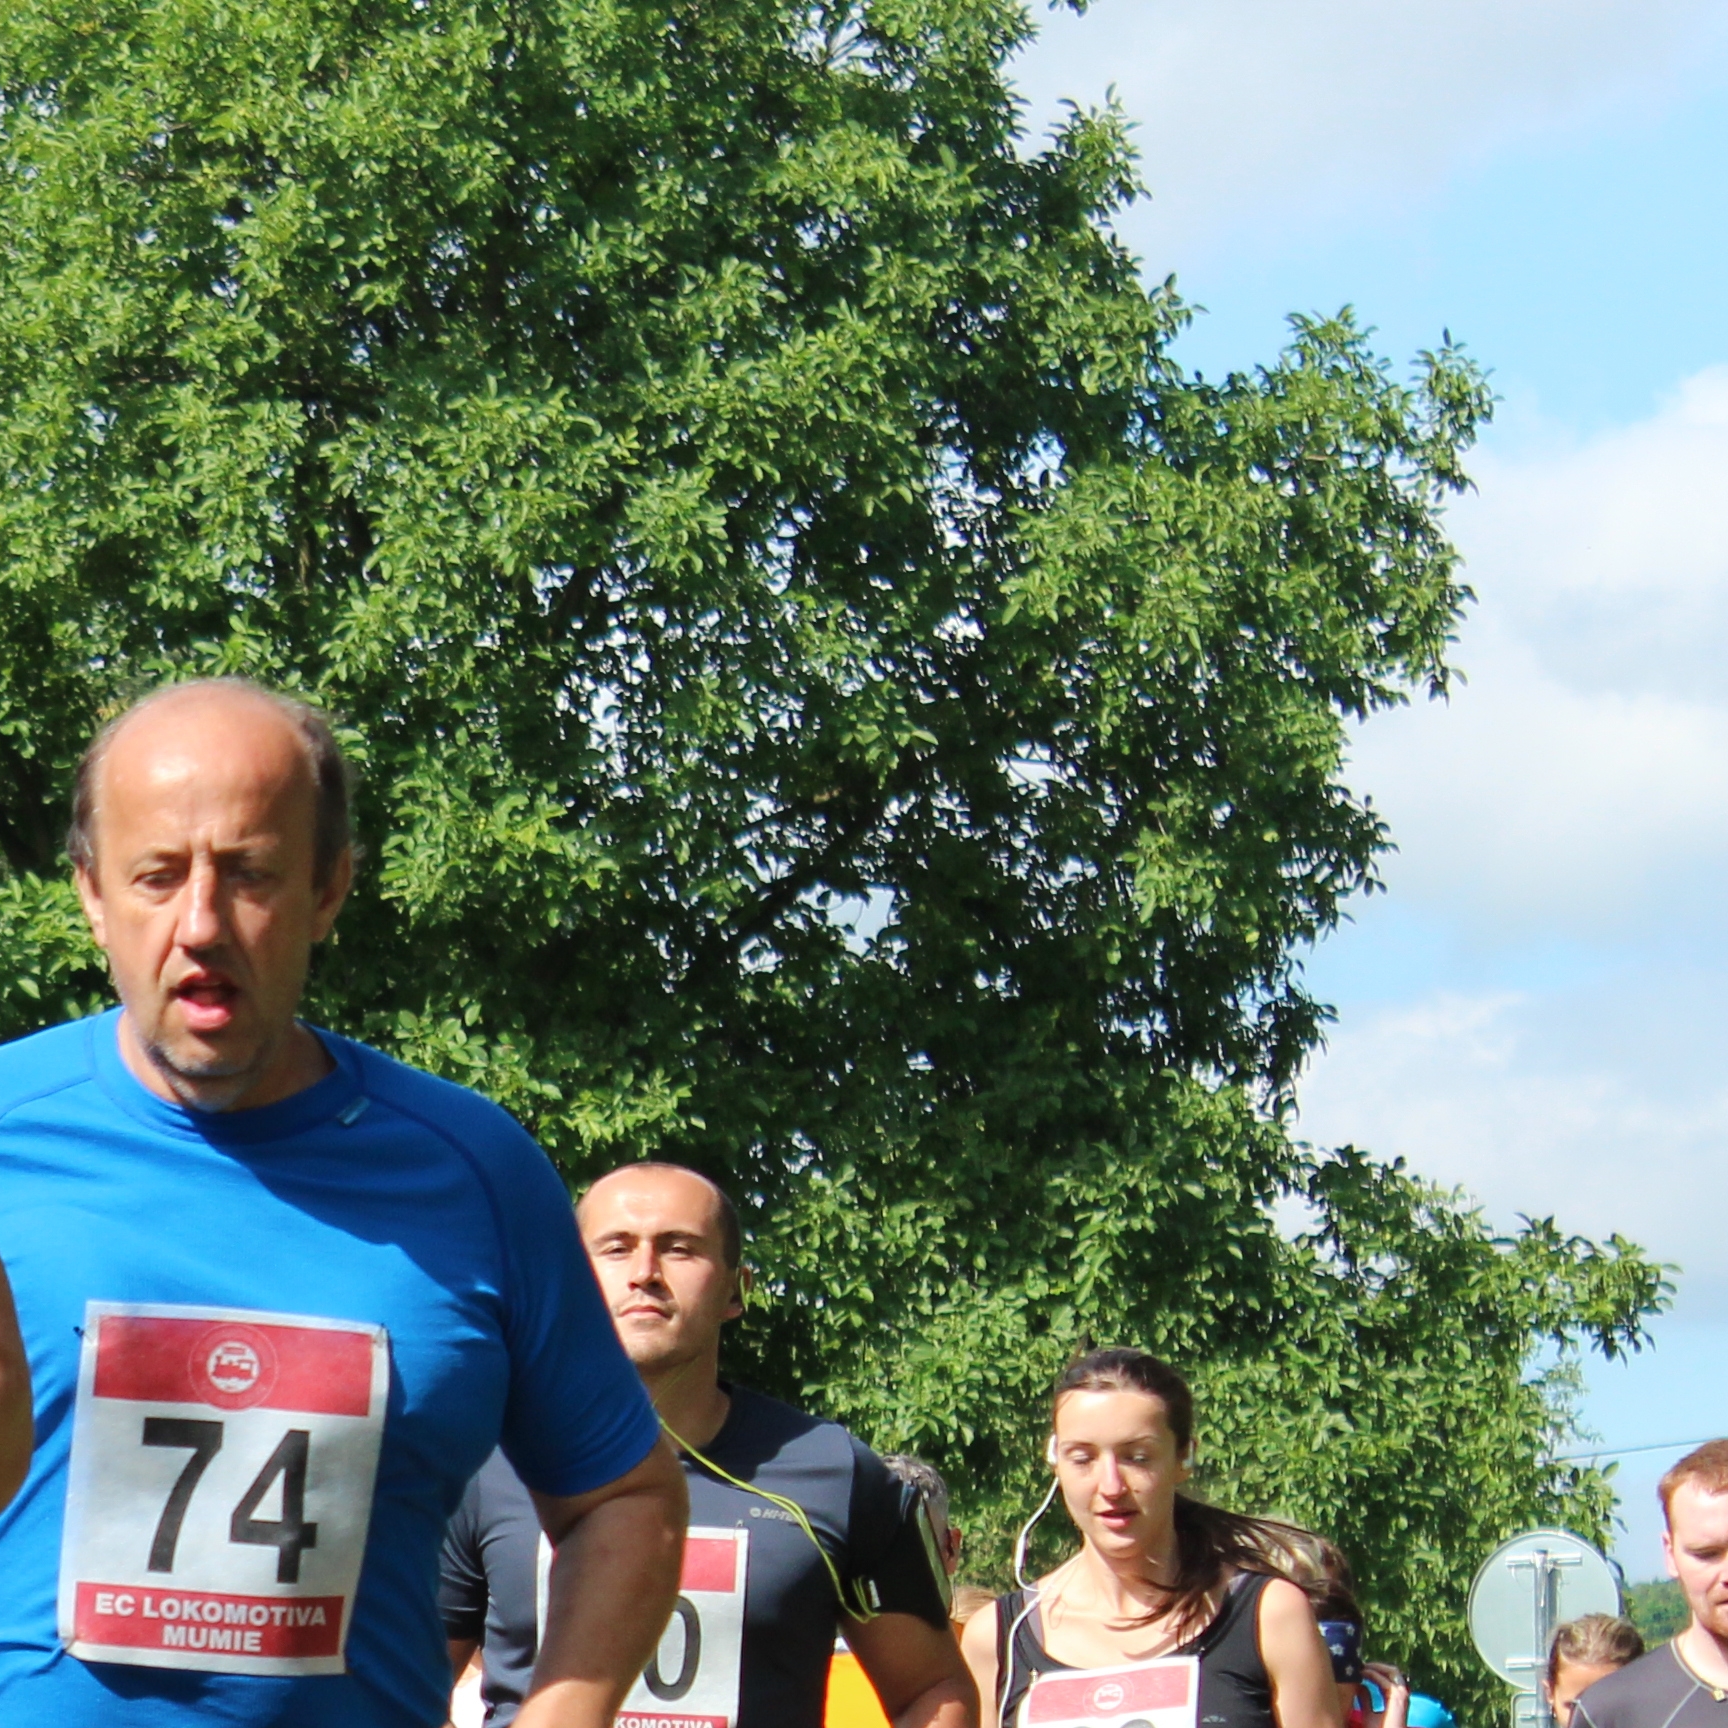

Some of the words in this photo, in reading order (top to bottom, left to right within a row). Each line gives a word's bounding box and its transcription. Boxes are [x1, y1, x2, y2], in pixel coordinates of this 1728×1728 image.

[141, 1416, 318, 1584] 74
[95, 1592, 136, 1616] EC
[142, 1595, 327, 1628] LOKOMOTIVA
[161, 1624, 263, 1653] MUMIE
